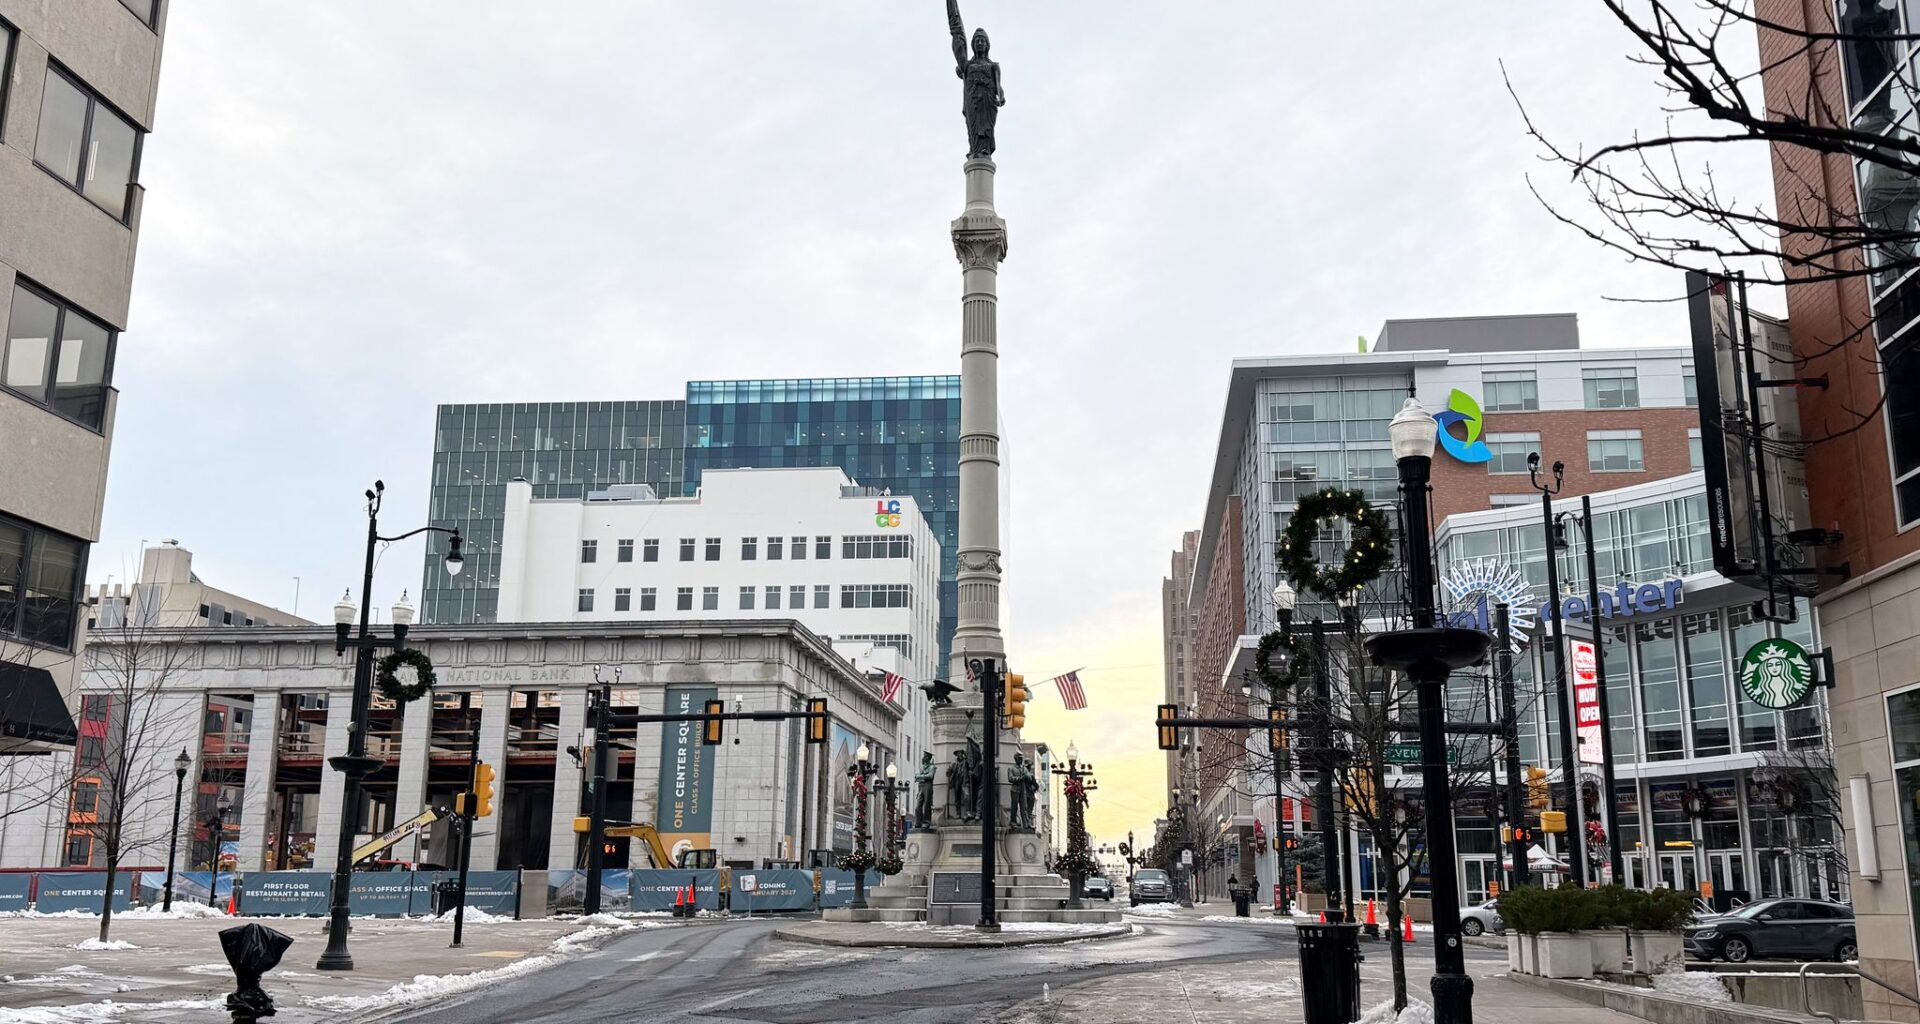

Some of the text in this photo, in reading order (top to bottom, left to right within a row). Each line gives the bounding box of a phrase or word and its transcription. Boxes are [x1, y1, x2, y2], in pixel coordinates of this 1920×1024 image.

[1715, 488, 1727, 542] mediaresources
[446, 668, 570, 682] NATIONAL BANK
[1578, 687, 1596, 703] NOW
[695, 709, 703, 746] BUILDIG
[676, 748, 687, 798] CENTER
[693, 748, 701, 778] OFFICE
[674, 801, 684, 829] ONE
[44, 889, 60, 897] ONE
[751, 888, 779, 896] ANUARY
